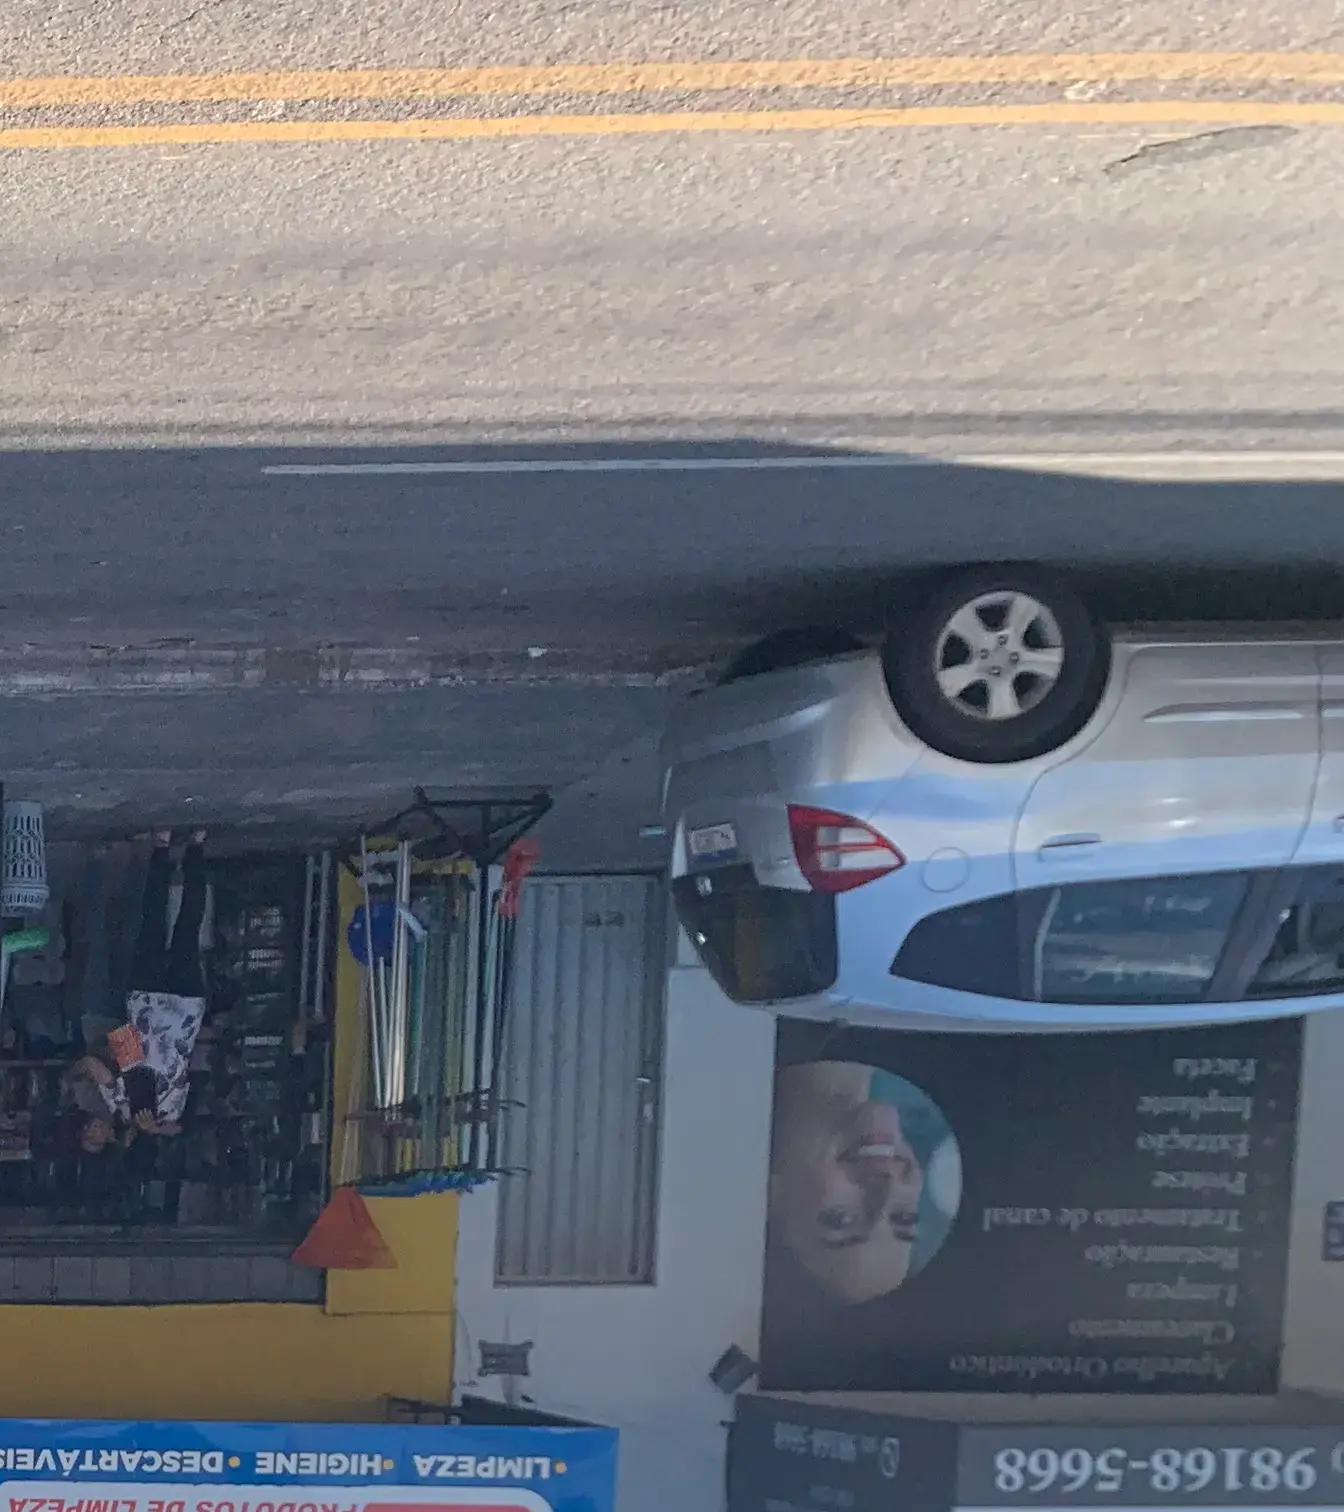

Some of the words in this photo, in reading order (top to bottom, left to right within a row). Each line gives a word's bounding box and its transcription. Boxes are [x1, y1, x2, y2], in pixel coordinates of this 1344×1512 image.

[982, 1207, 1052, 1232] canal
[1058, 1208, 1089, 1232] de
[1094, 1208, 1243, 1232] Tratamento
[254, 1451, 383, 1476] HIGIENE
[412, 1452, 551, 1479] LIMPEZA
[994, 1446, 1317, 1492] 98168-5668
